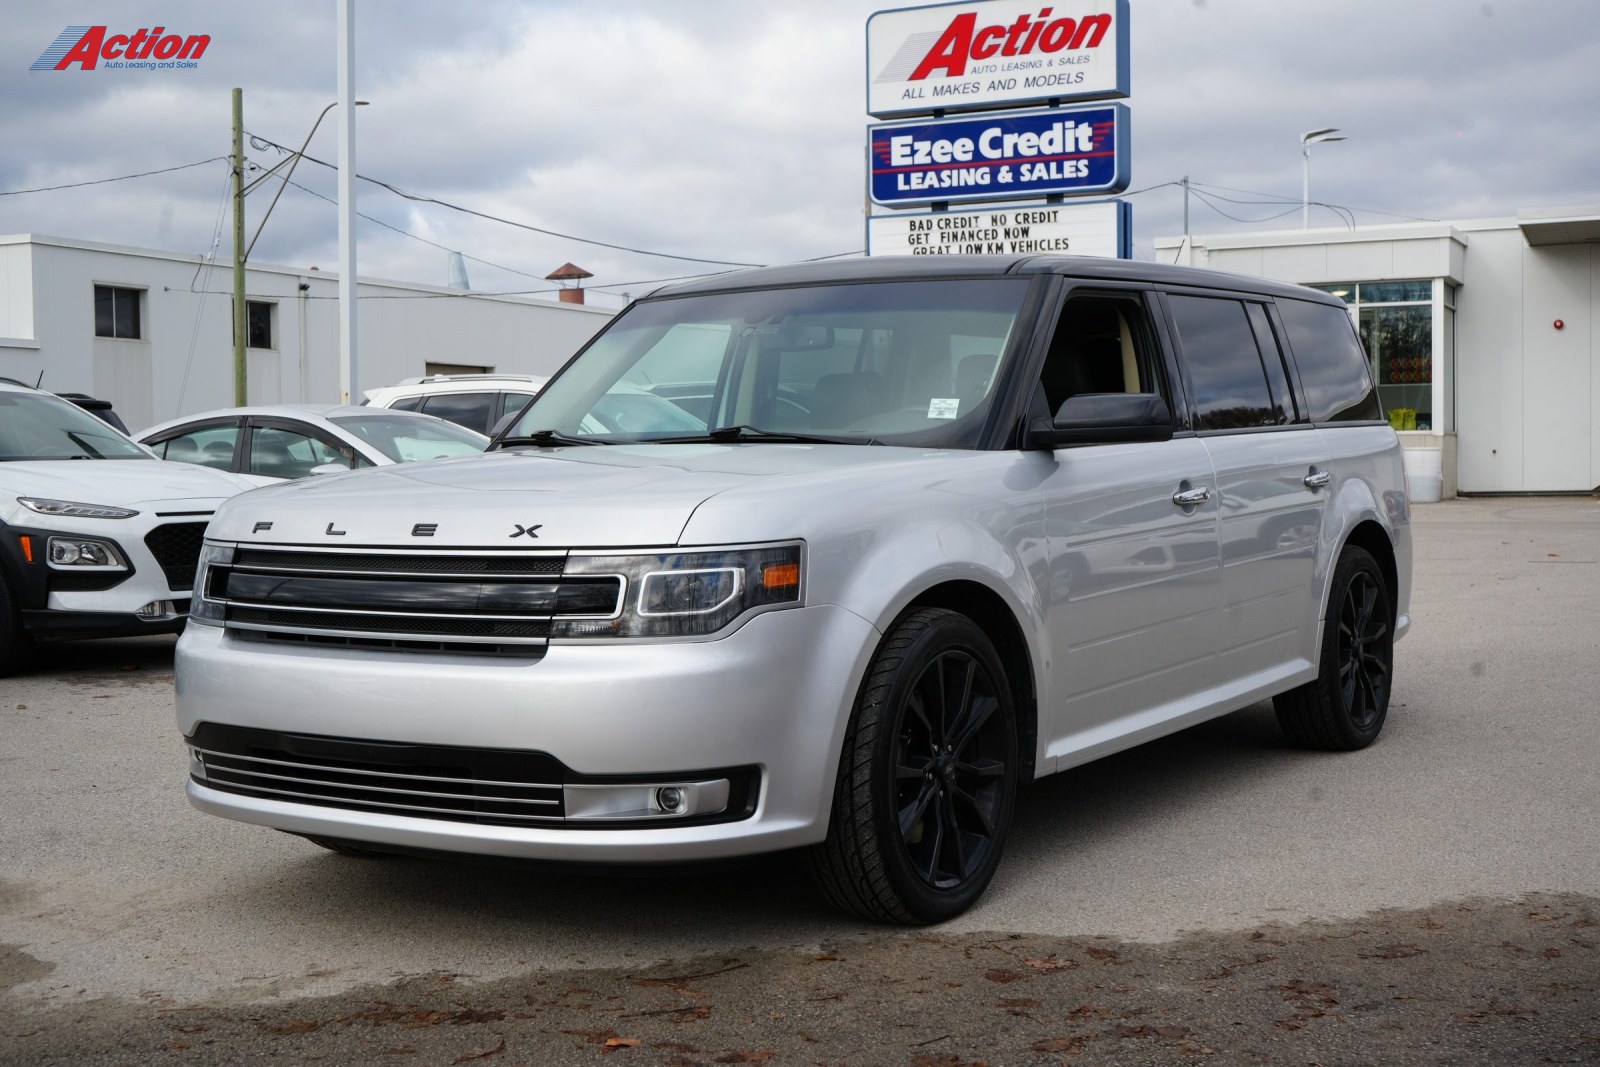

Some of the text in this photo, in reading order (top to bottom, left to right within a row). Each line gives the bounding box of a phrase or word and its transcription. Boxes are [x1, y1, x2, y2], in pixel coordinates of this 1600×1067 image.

[907, 7, 1112, 81] Action
[970, 54, 1090, 75] AUTO LEASING & SALES
[901, 71, 1085, 100] ALL MAKES AND MODELS
[890, 120, 1094, 167] Ezee Credit
[897, 159, 1089, 191] LEASING & SALES
[909, 211, 1059, 231] BAD CREDIT NO CREDIT
[908, 226, 1030, 245] GET FINANCED NOW
[912, 245, 952, 256] GREAT
[987, 242, 1004, 255] KM
[1010, 238, 1069, 253] VEHICLES
[252, 521, 543, 538] FLEX
